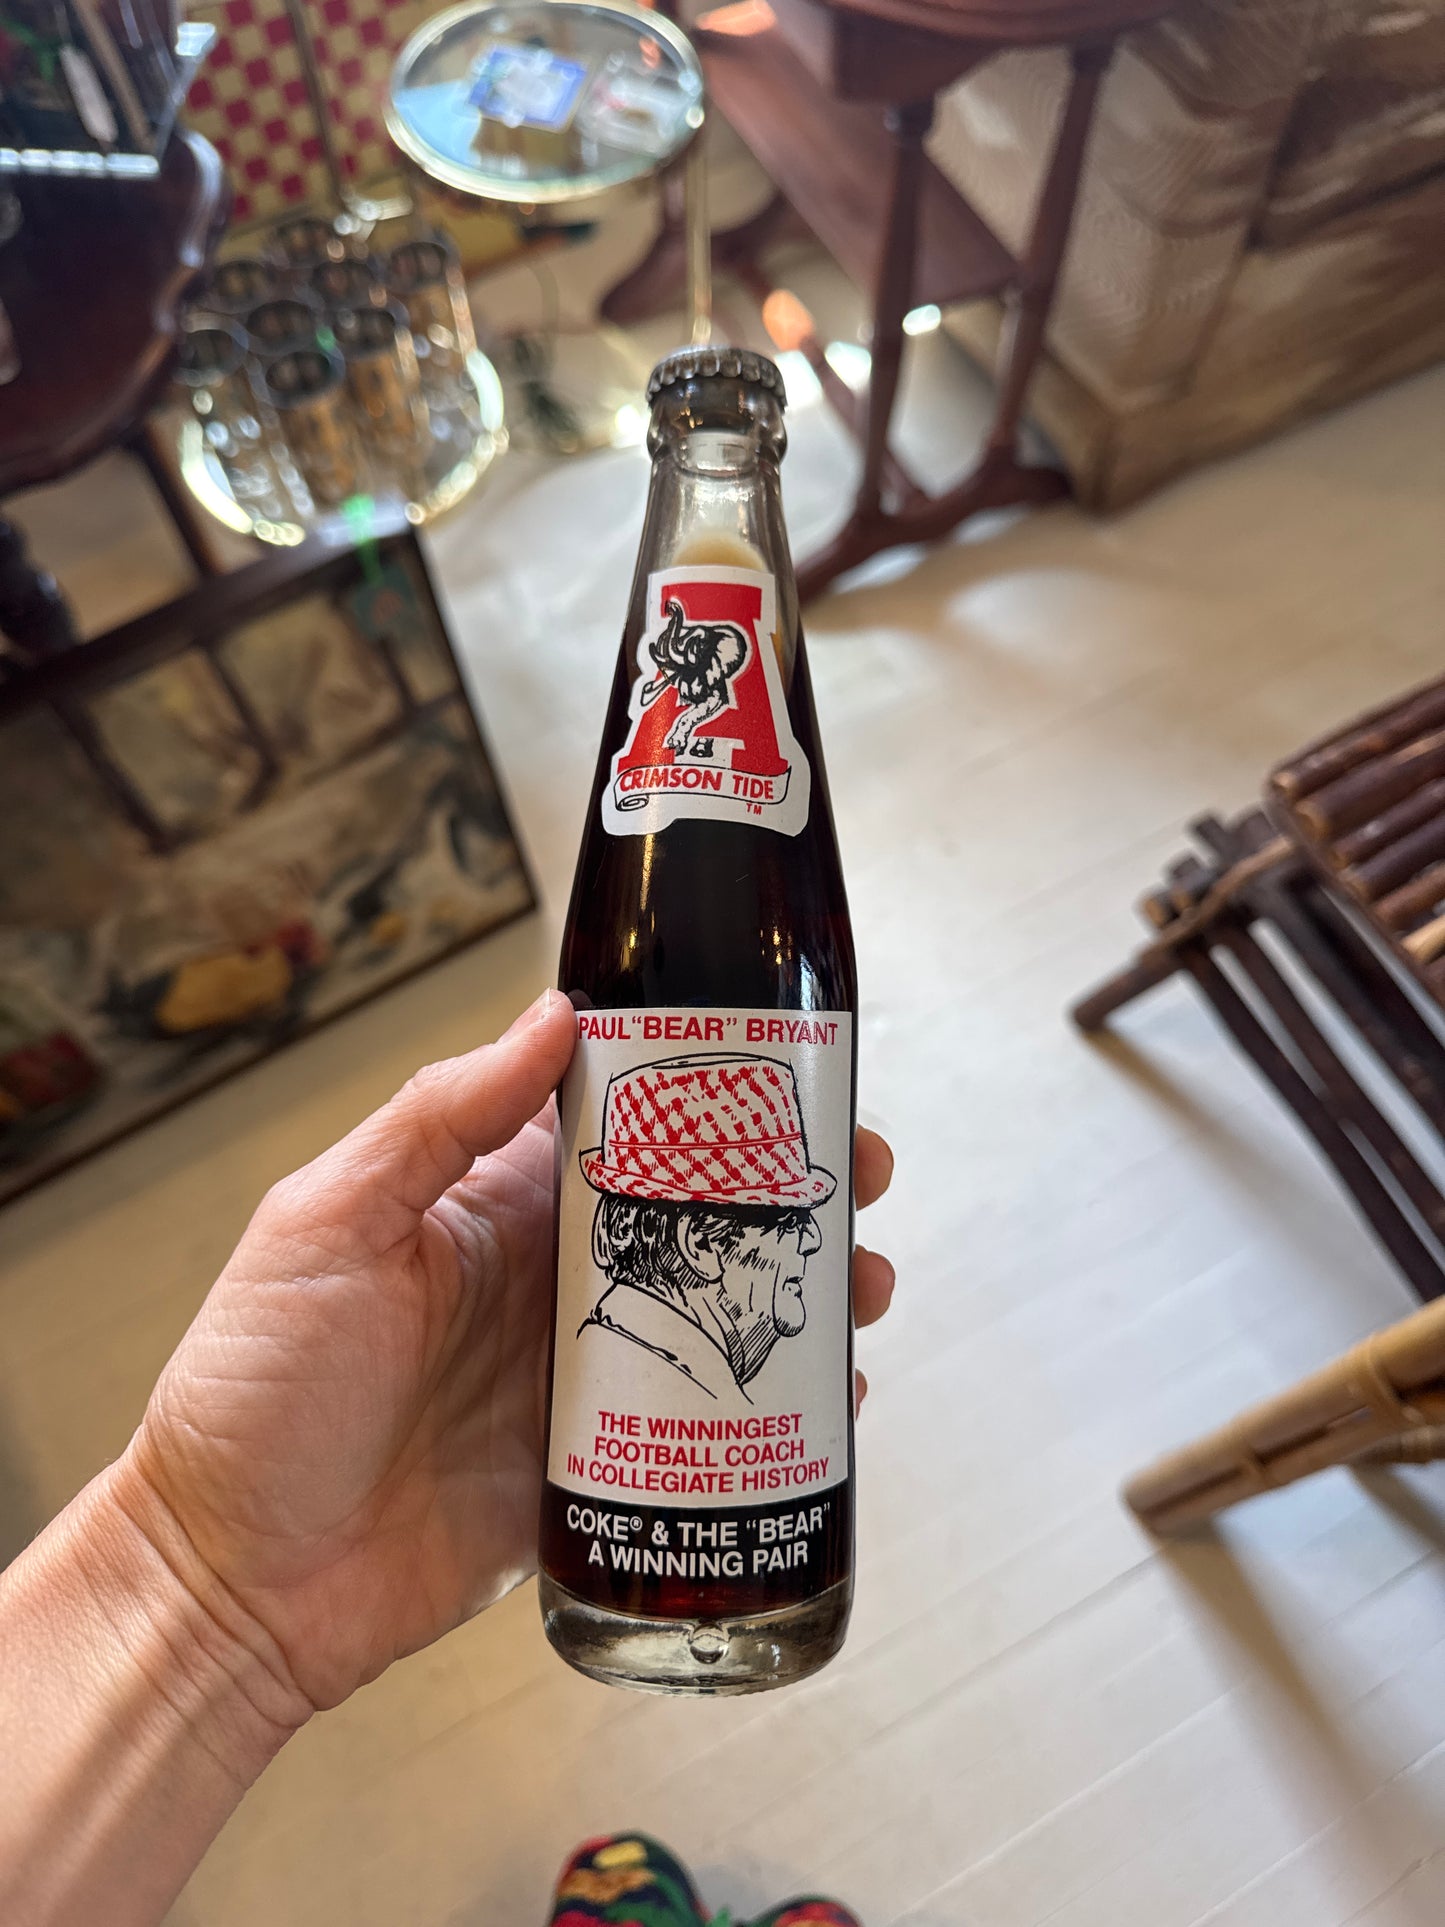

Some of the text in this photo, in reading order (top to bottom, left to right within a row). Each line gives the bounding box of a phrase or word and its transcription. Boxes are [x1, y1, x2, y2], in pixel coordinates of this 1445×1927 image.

[619, 767, 774, 800] CRIMSON TIDE
[578, 1016, 631, 1040] PAUL
[746, 1018, 838, 1045] BRYANT
[598, 1410, 803, 1441] THE WINNINGEST
[594, 1435, 805, 1468] FOOTBALL COACH
[567, 1453, 829, 1493] IN COLLEGIATE HISTORY
[651, 1520, 670, 1546] &
[677, 1522, 738, 1547] THE
[588, 1541, 808, 1578] A WINNING PAIR
